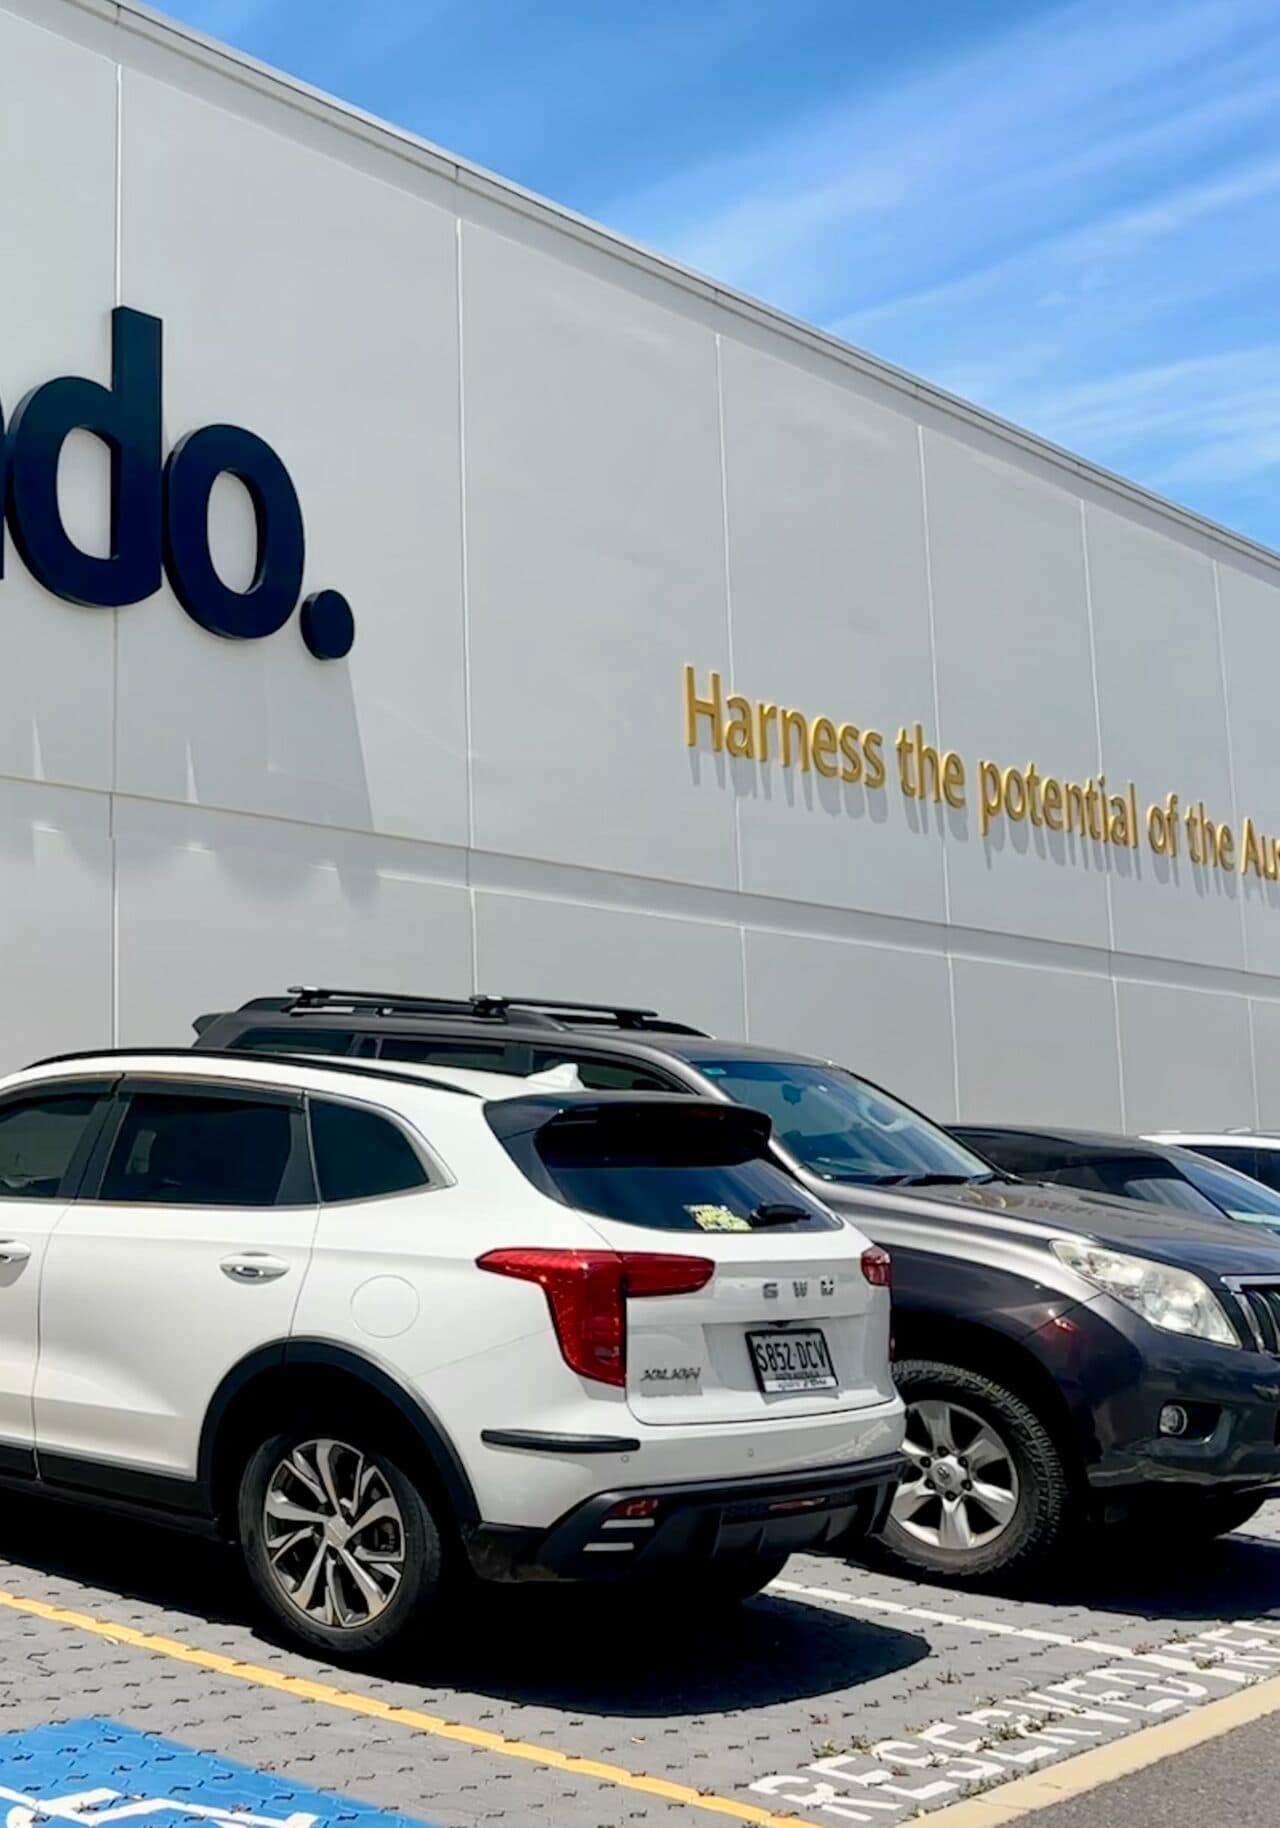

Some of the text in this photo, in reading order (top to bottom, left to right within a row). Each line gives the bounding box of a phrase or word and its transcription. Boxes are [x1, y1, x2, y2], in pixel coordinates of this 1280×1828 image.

[683, 664, 886, 789] Harness
[895, 722, 966, 809] the
[978, 760, 1138, 849] potential
[1146, 792, 1178, 858] of
[1184, 799, 1235, 872] the
[748, 1668, 1209, 1821] RESERVED
